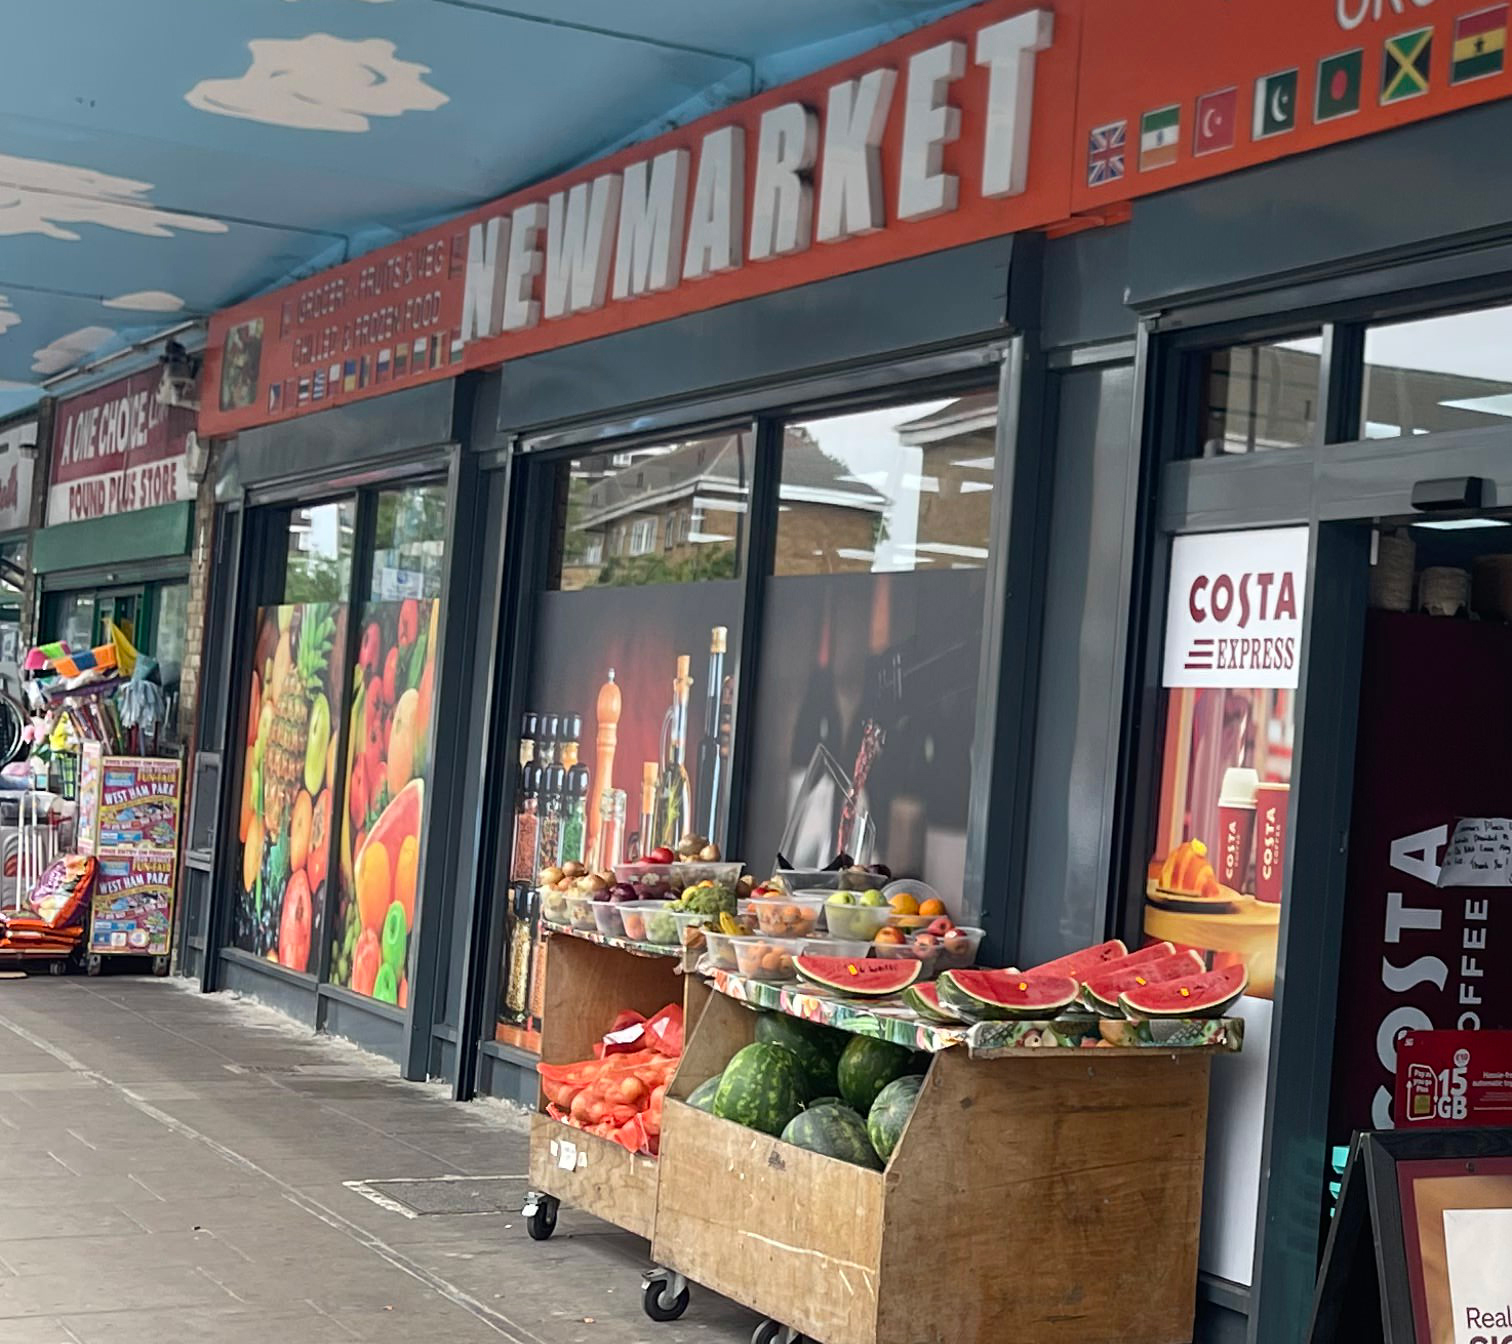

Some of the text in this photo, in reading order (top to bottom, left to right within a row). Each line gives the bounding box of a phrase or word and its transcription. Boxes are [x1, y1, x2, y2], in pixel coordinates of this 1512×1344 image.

[460, 8, 1054, 342] NEWMARKET
[359, 256, 402, 299] FRUITS
[404, 290, 442, 330] FOOD
[61, 416, 74, 465] A
[73, 406, 100, 462] ONE
[69, 481, 106, 521] POUND
[109, 470, 137, 513] PLUS
[140, 462, 177, 507] STORE
[1189, 571, 1298, 629] COSTA
[1216, 637, 1295, 670] EXPRESS
[104, 782, 175, 805] WEST HAM PARK
[1226, 821, 1237, 880] COSTA
[1262, 807, 1276, 880] COSTA
[99, 871, 170, 894] WEST HAM PARK
[1457, 899, 1489, 1031] OFFEE
[1438, 1067, 1468, 1097] 15
[1437, 1095, 1468, 1120] GB
